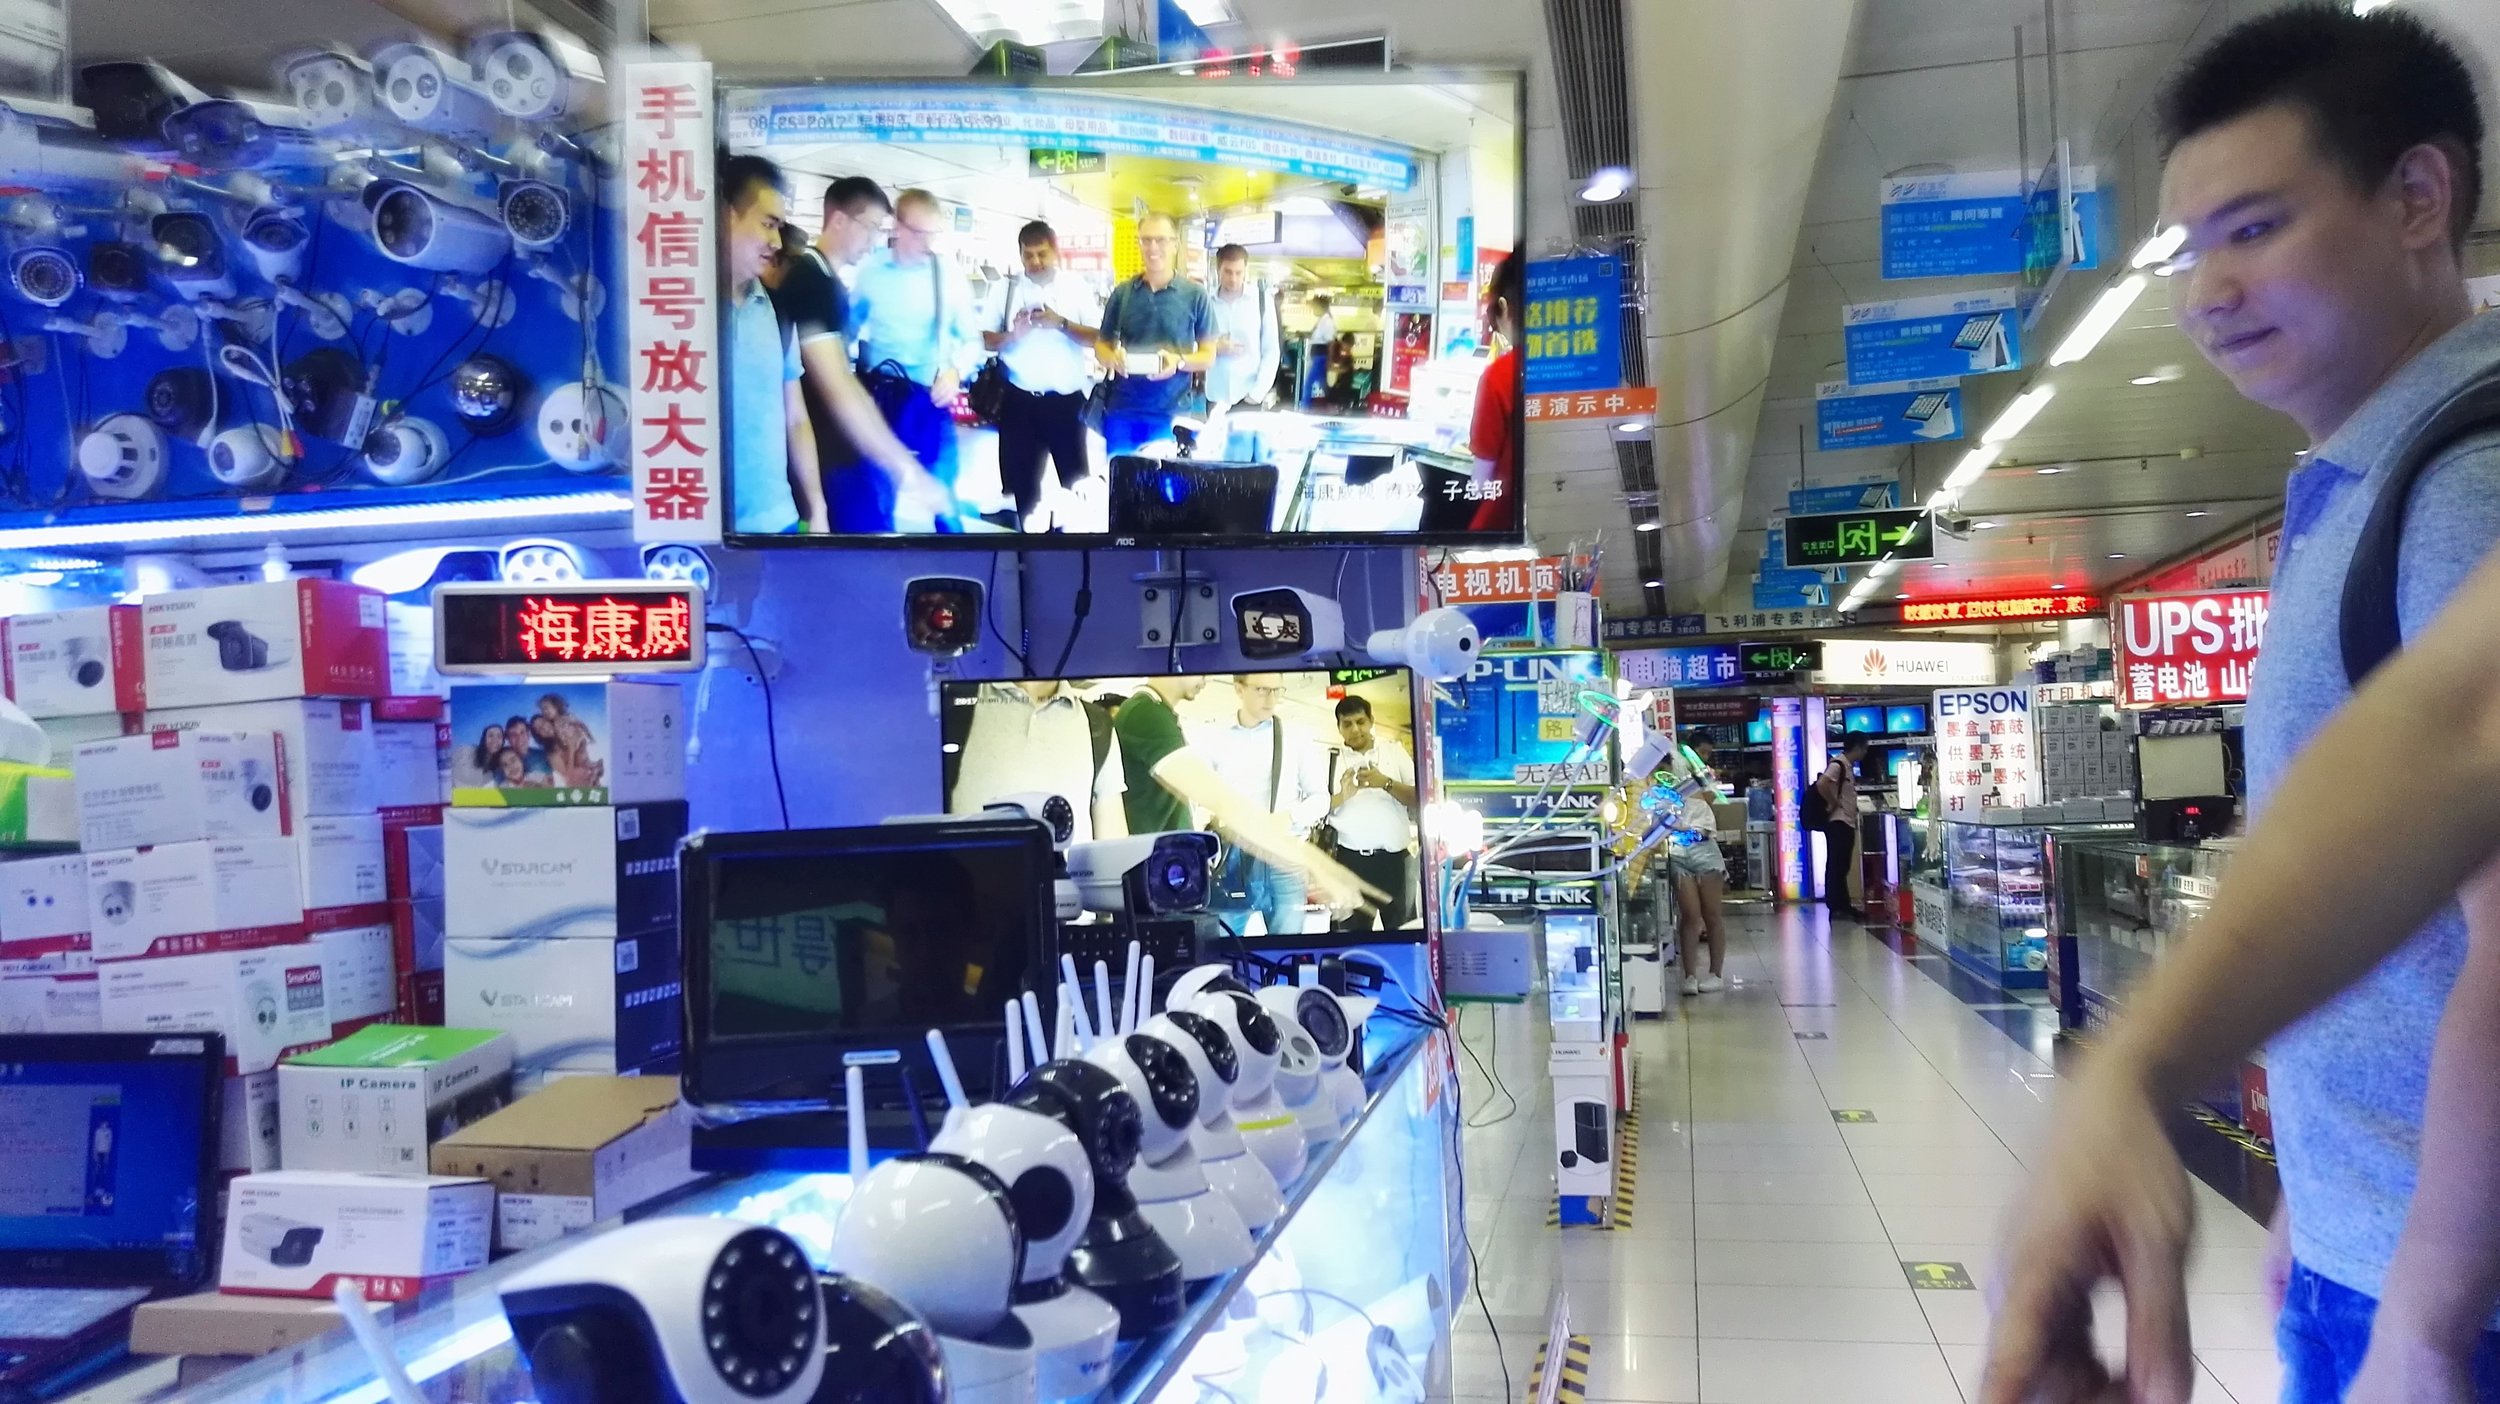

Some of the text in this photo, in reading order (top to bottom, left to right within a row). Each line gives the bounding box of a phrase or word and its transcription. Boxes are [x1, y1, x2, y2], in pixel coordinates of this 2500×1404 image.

[636, 83, 710, 521] 手机信号放大器
[1116, 538, 1135, 546] AOC
[518, 597, 689, 660] 海康威
[1896, 660, 1949, 673] HUAWEI
[2129, 659, 2210, 701] 蓄电池
[1939, 690, 2028, 717] EPSON
[1947, 718, 2025, 737] 墨盒 硒鼓
[1948, 743, 2026, 762] 供墨系统
[1949, 767, 2027, 786] 碳粉 墨水
[1511, 795, 1599, 809] TP-LINK
[1499, 888, 1592, 904] TPLINK
[340, 1078, 416, 1089] IP Camera
